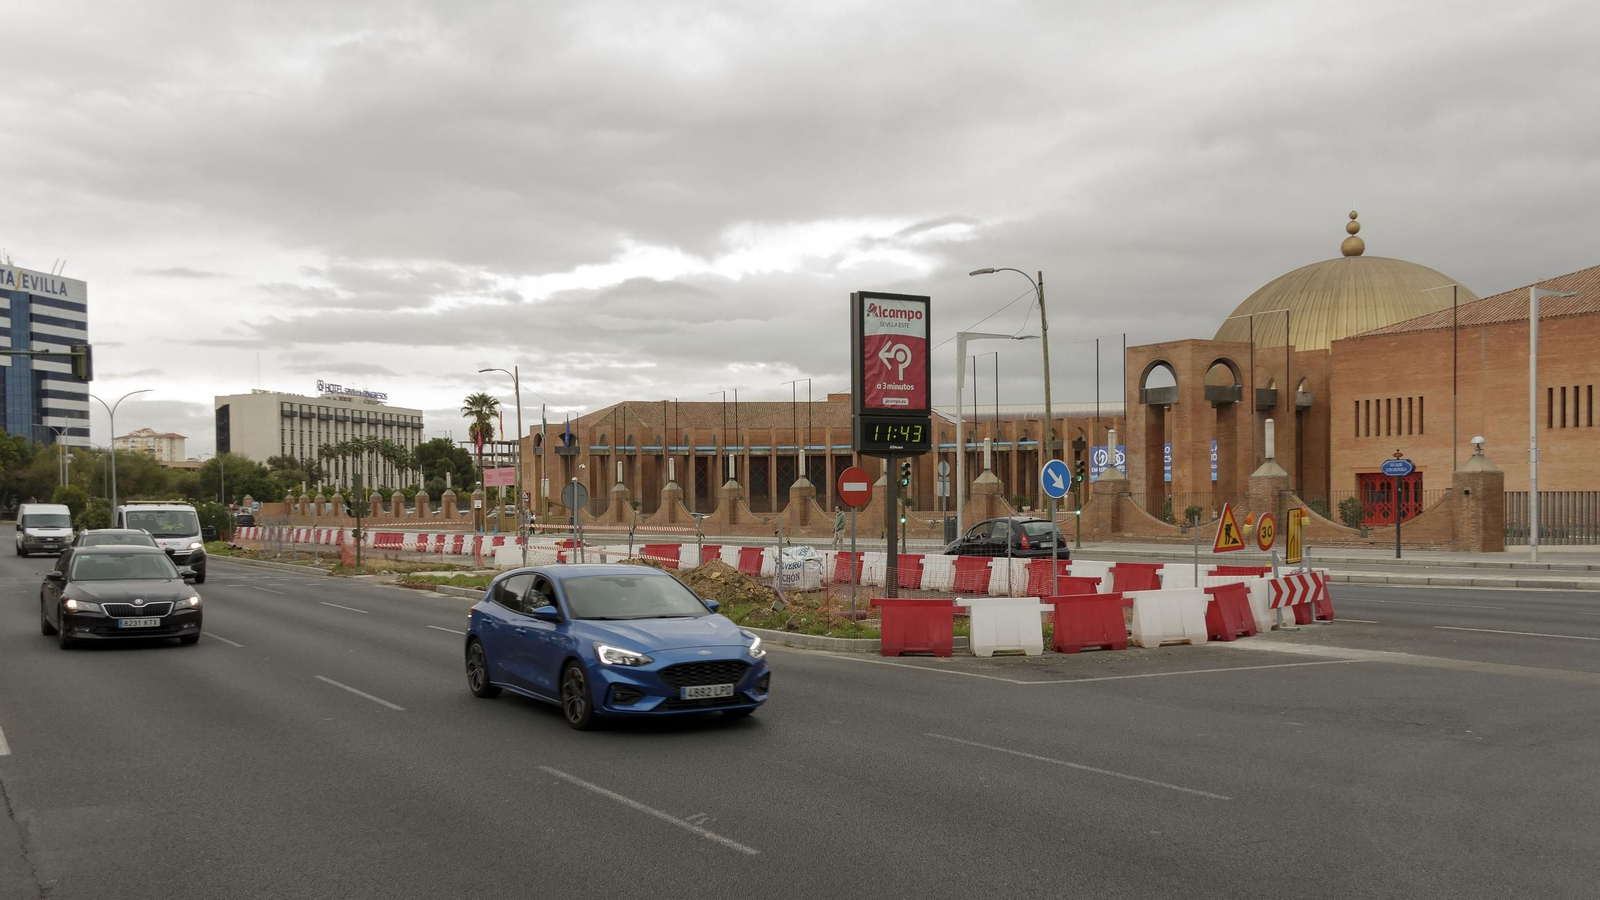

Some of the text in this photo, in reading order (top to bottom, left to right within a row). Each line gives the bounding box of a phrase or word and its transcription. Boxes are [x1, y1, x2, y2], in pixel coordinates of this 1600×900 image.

[866, 303, 923, 321] Alcampo
[325, 383, 343, 395] HOTEL
[887, 382, 914, 391] minutos
[874, 425, 923, 442] 11:43
[1261, 525, 1272, 538] 30
[688, 687, 711, 697] 4882
